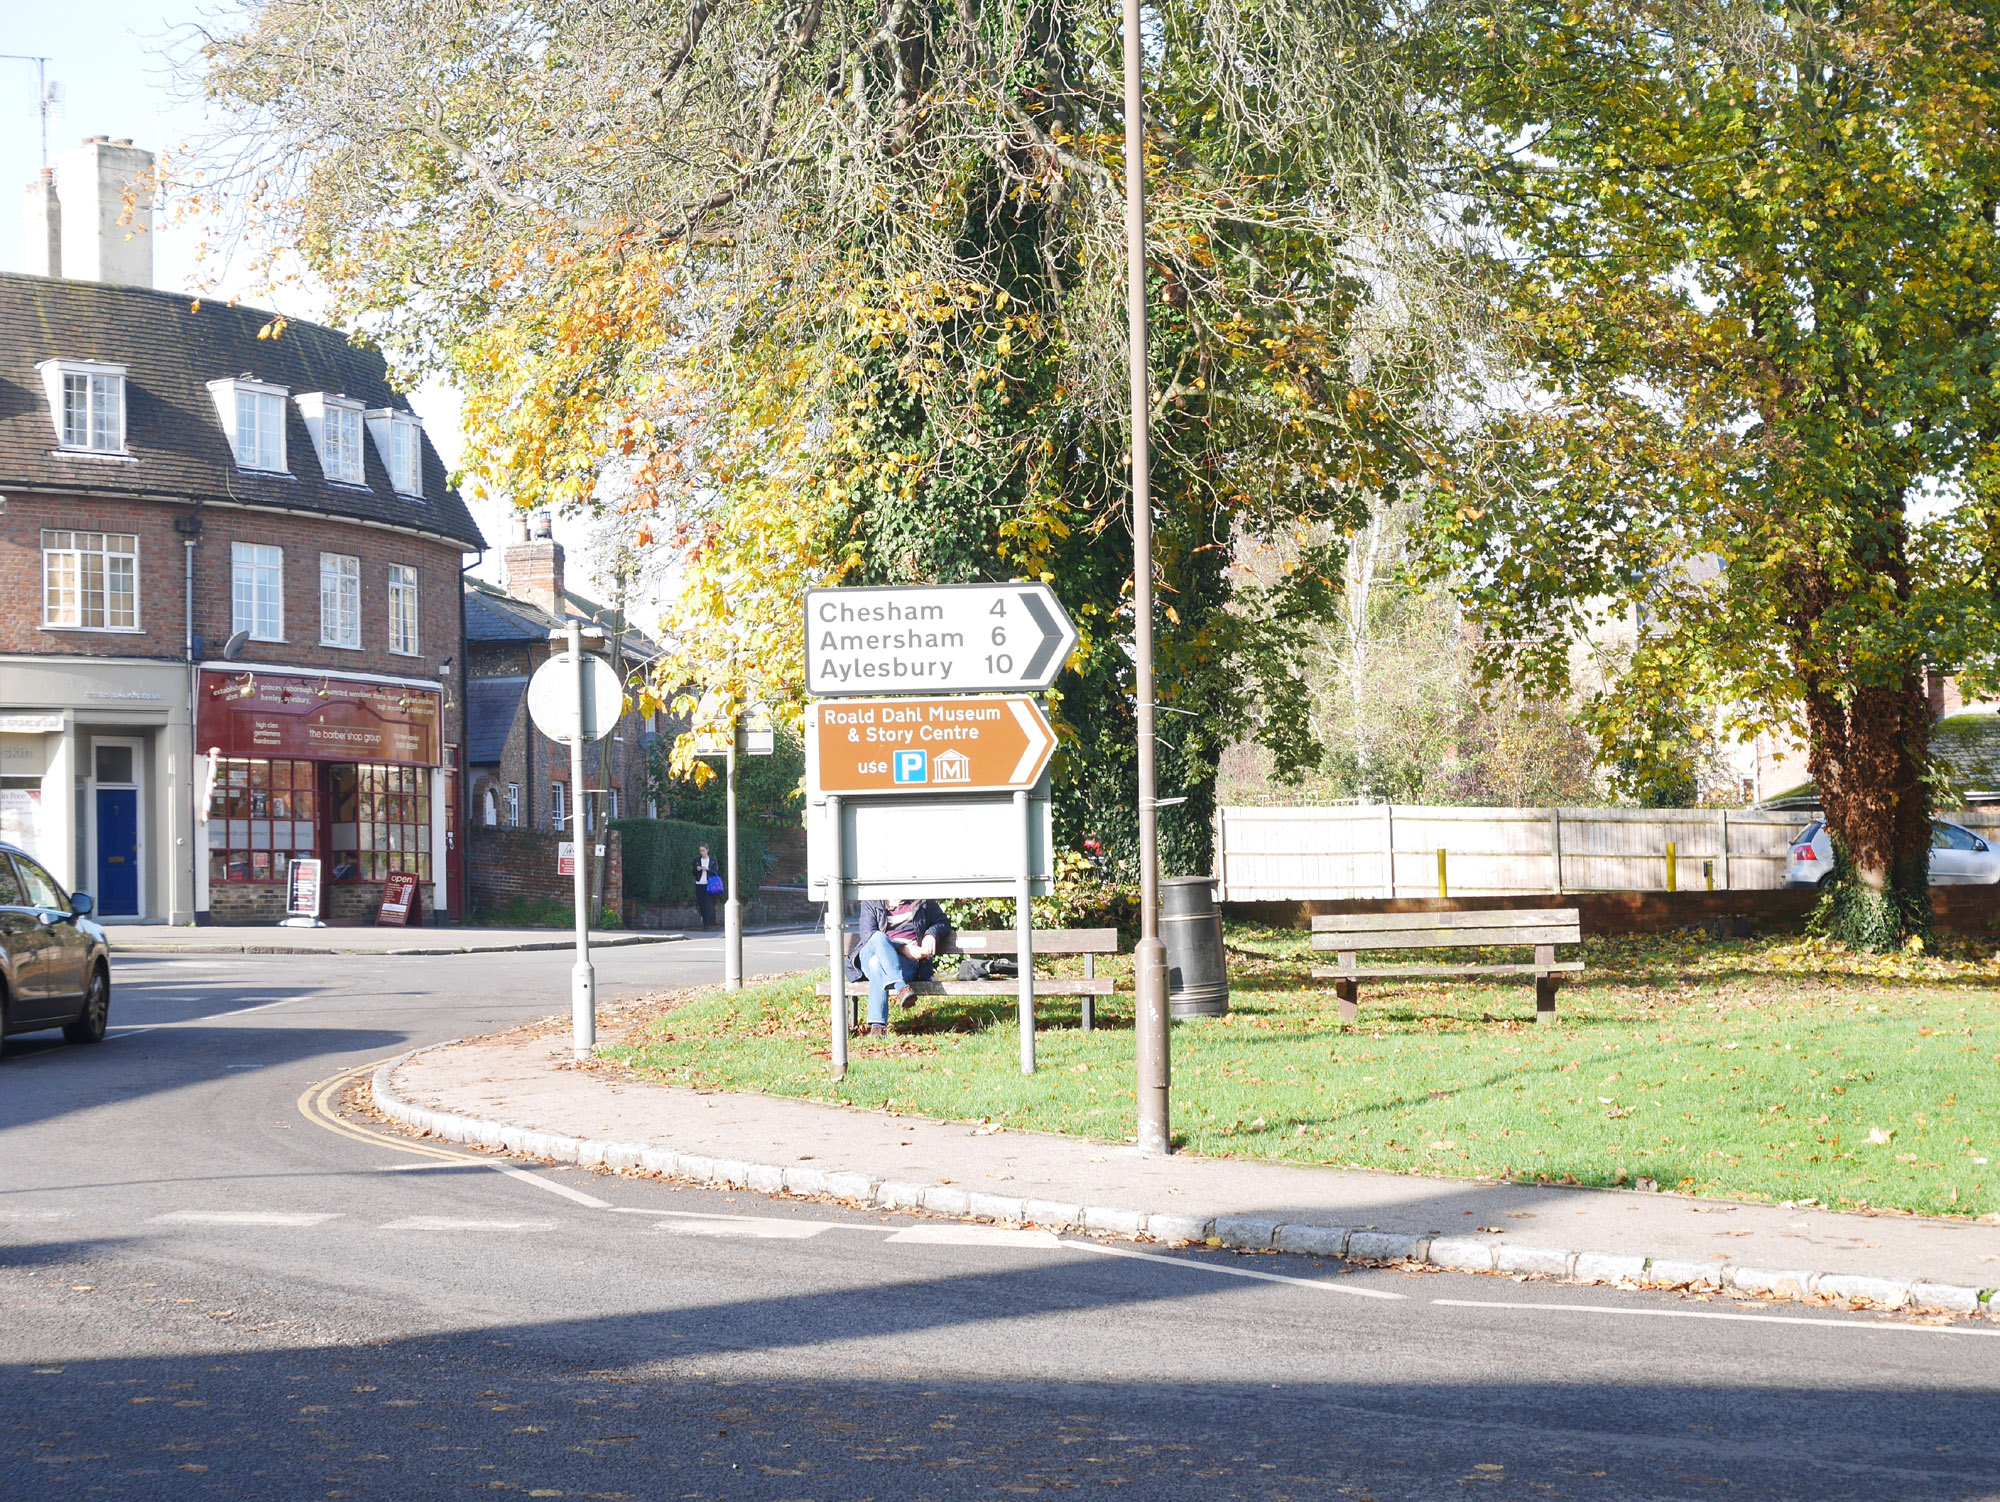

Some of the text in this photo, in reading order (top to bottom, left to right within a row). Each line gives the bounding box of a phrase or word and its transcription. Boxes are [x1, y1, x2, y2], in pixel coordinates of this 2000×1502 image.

[819, 598, 1007, 623] Chesham 4
[819, 626, 1006, 651] Amersham 6
[819, 653, 1013, 682] Aylesbury 10
[260, 683, 282, 694] princes
[824, 705, 1001, 725] Roald Dahl Museum
[309, 729, 381, 743] the barber shop group
[848, 724, 979, 744] & Story Centre
[858, 761, 888, 775] use
[901, 753, 923, 780] P
[391, 875, 413, 884] open
